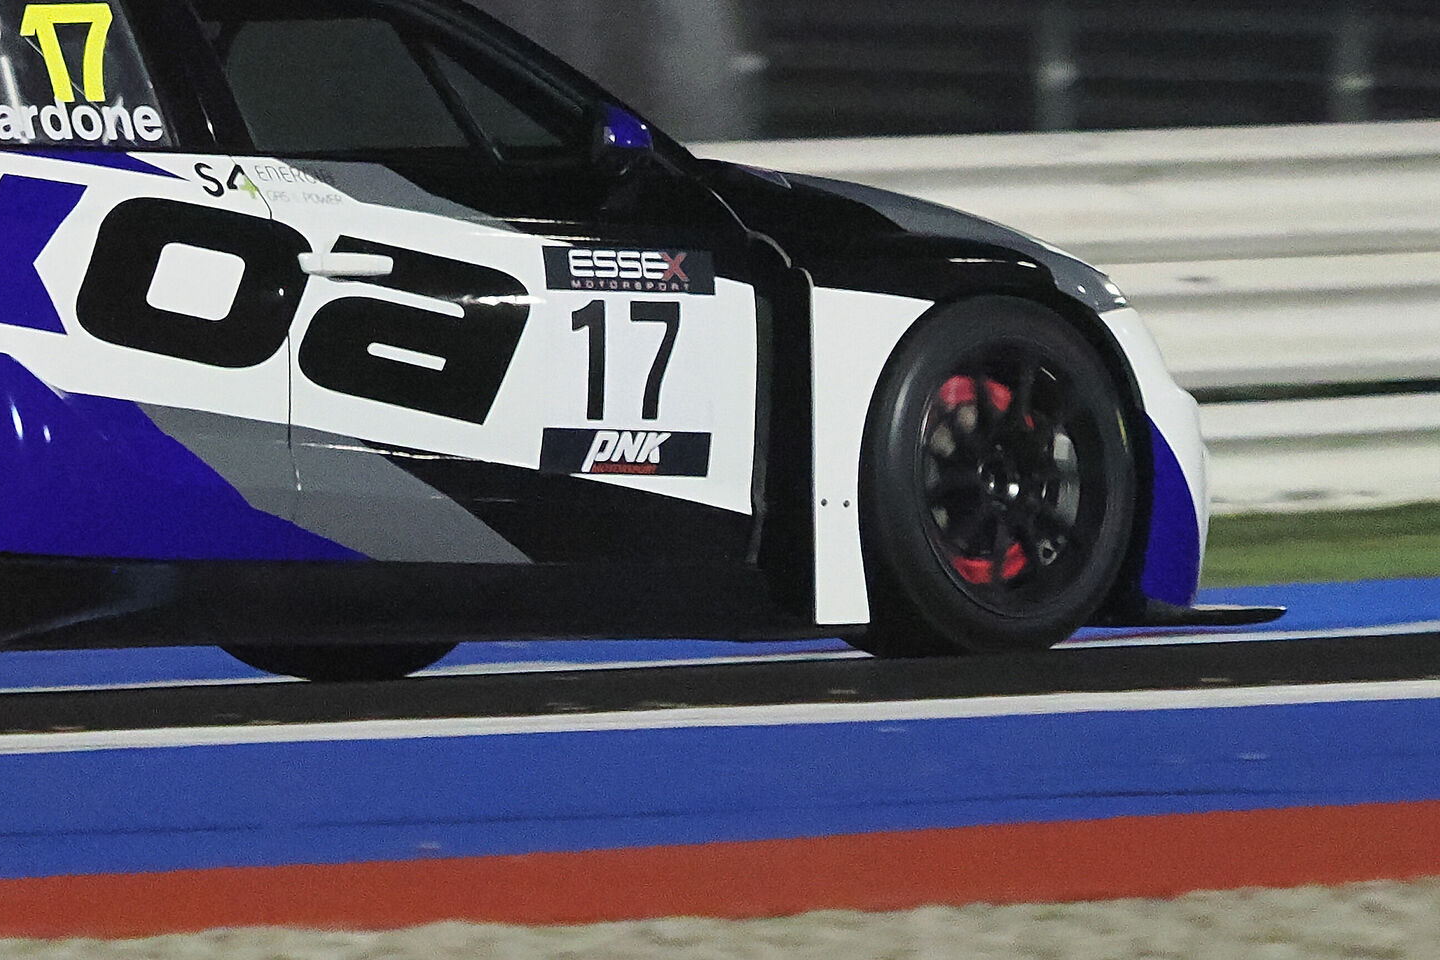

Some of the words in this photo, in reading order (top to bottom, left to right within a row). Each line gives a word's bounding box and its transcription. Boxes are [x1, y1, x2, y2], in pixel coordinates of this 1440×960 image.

[20, 3, 113, 102] 17
[568, 249, 690, 281] ESSEX
[571, 279, 689, 290] MOTORSPORT
[572, 300, 680, 420] 17
[581, 430, 672, 472] PNK
